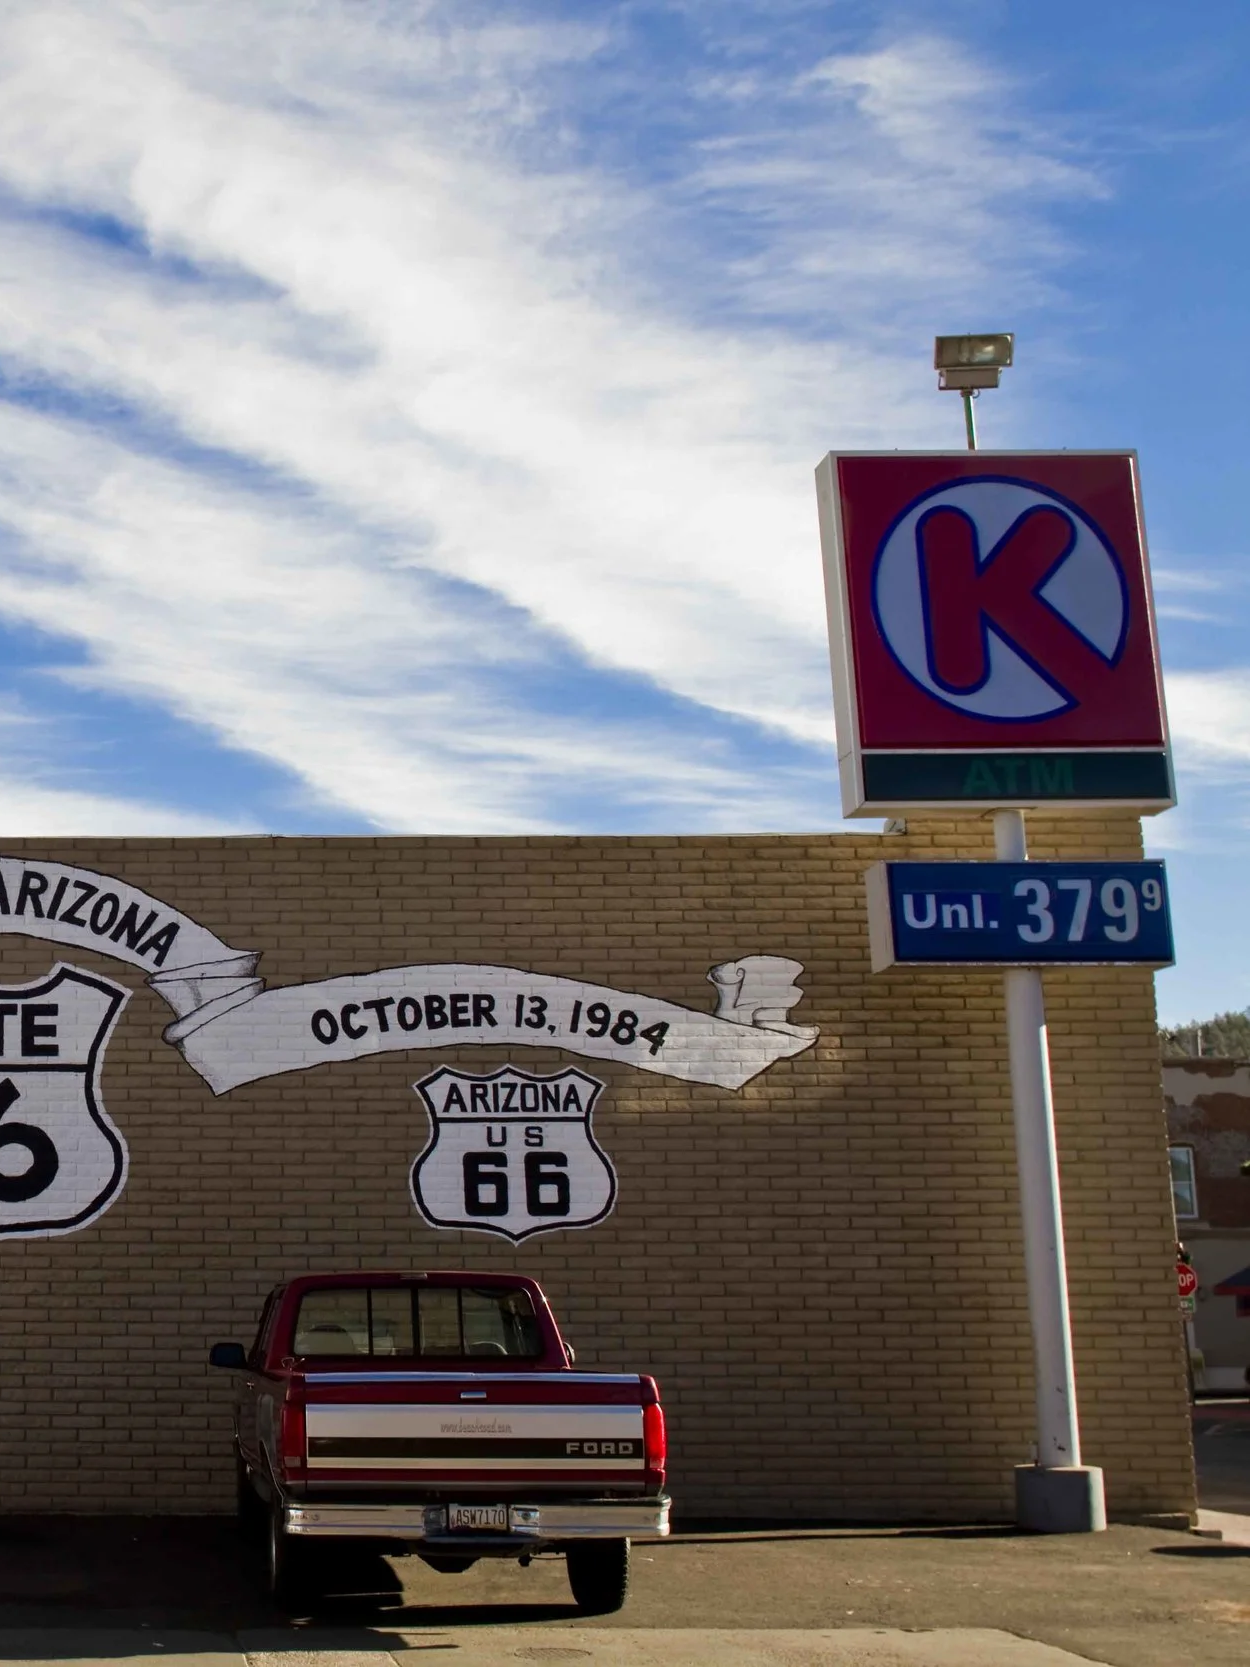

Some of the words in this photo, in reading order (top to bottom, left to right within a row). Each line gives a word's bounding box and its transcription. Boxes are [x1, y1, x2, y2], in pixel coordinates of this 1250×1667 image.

[962, 757, 1075, 795] ATM
[902, 893, 998, 929] Unl.
[311, 994, 498, 1045] OCTOBER
[514, 994, 556, 1034] 13,
[569, 1000, 670, 1056] 1984
[442, 1083, 583, 1114] ARIZONA
[463, 1151, 570, 1217] 66
[1178, 1273, 1194, 1286] OP
[566, 1442, 633, 1455] FORD
